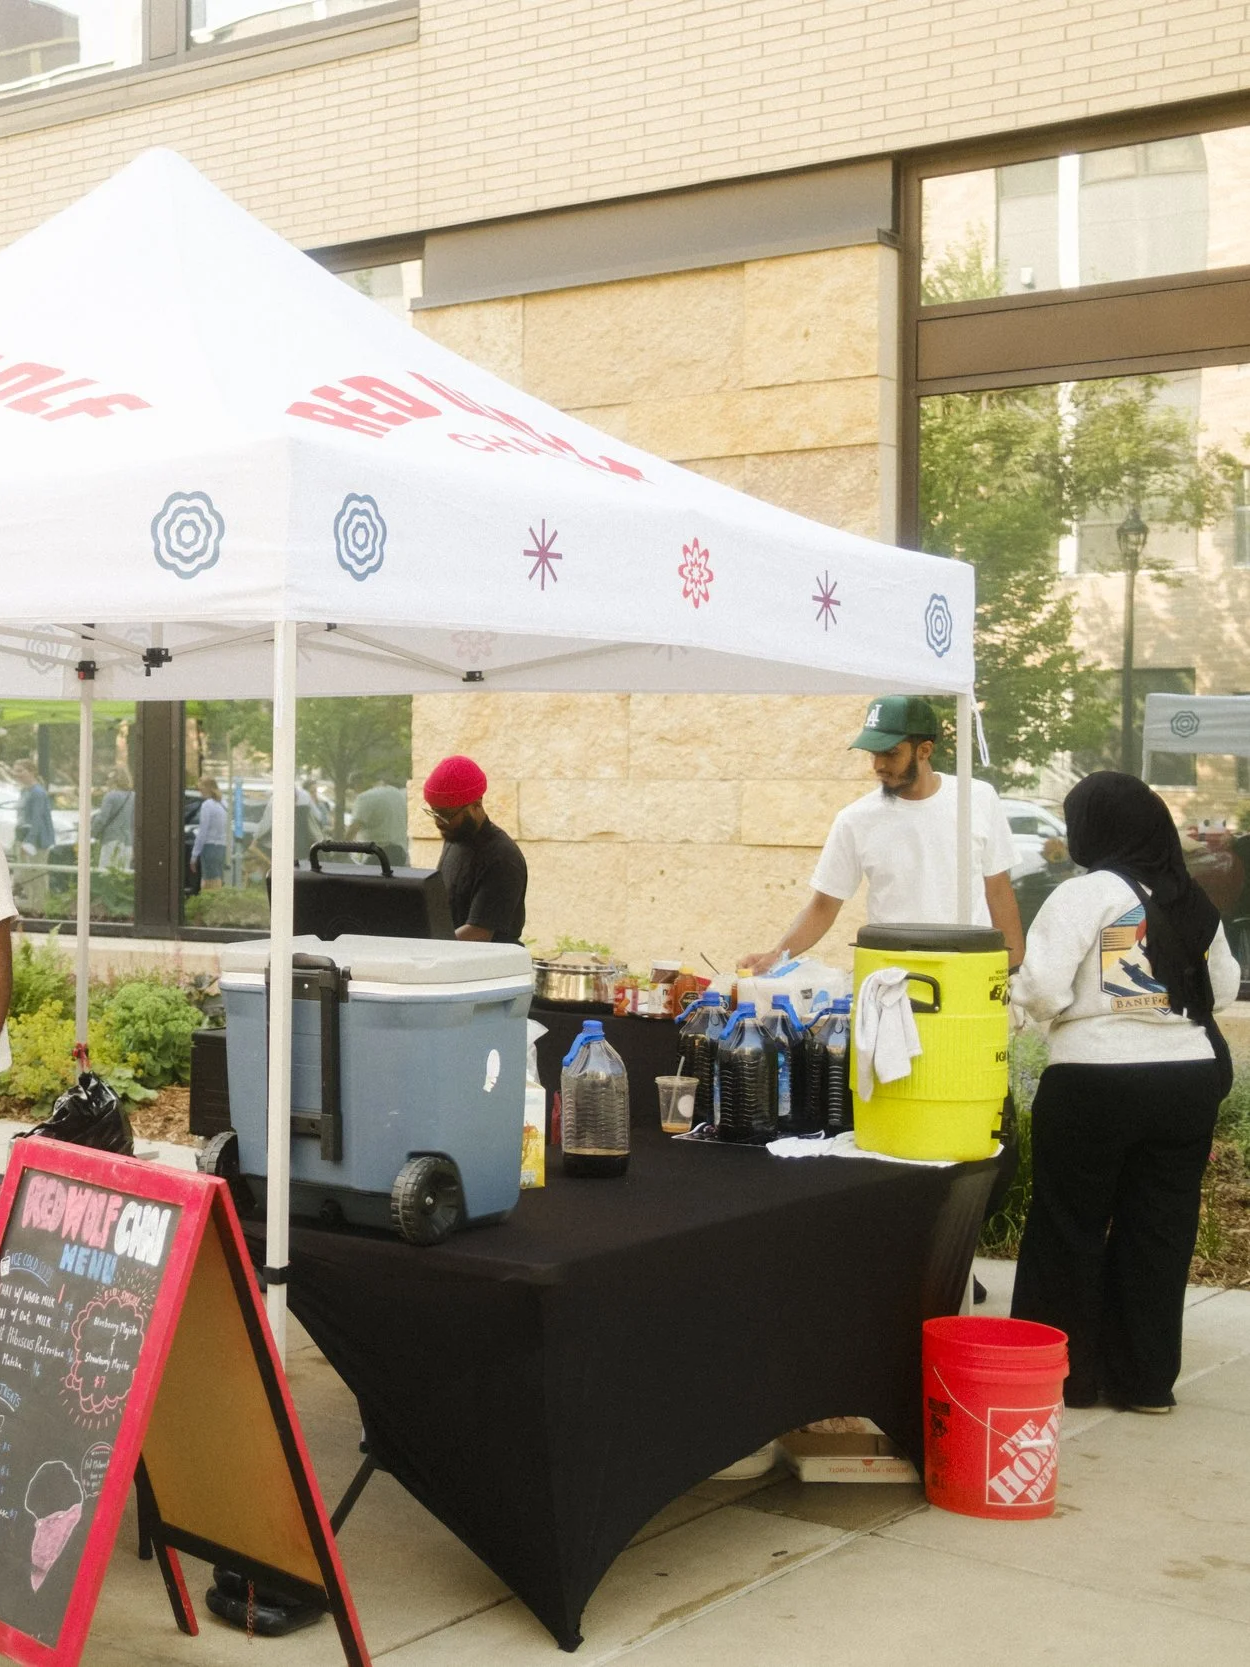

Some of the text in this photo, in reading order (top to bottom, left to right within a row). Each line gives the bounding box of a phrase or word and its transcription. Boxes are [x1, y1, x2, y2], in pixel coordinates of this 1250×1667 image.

[285, 375, 442, 438] RED
[1116, 996, 1158, 1009] BANFF
[21, 1175, 172, 1267] RED WOLF CHAI
[59, 1243, 119, 1285] MENU
[120, 1321, 138, 1340] Mojito
[111, 1358, 130, 1374] Mojito
[94, 1375, 106, 1389] $7
[999, 1419, 1040, 1458] THE
